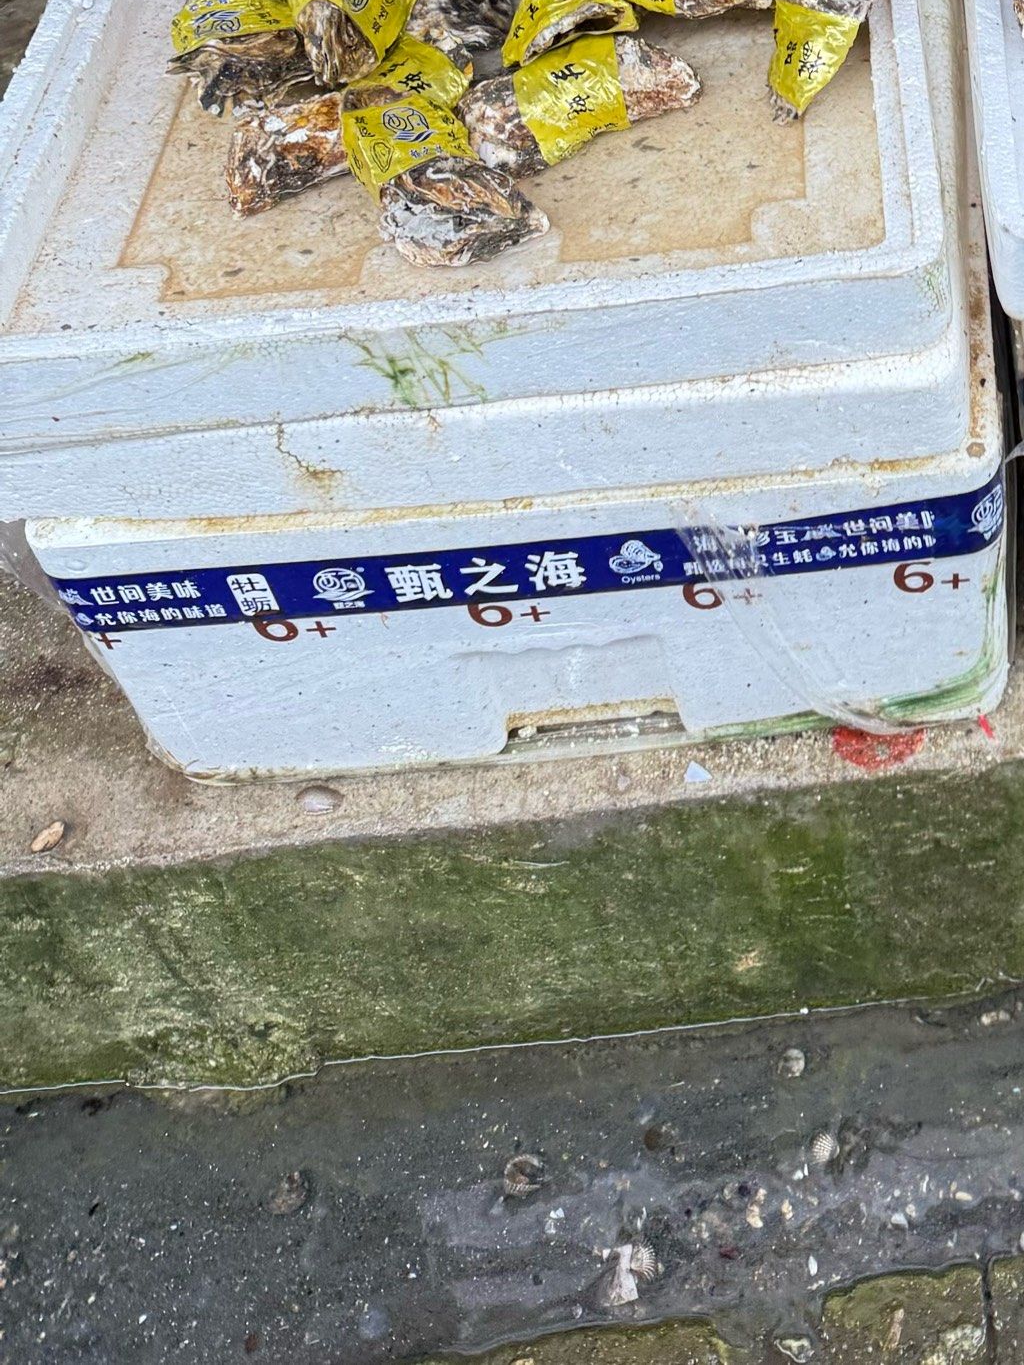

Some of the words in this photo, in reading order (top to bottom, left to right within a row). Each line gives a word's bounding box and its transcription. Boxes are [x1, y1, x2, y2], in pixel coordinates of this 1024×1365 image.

[384, 551, 588, 603] 甄之海
[621, 572, 661, 585] Oysters
[893, 561, 971, 594] 6+
[90, 579, 202, 607] 世间美味
[468, 601, 551, 627] 6+
